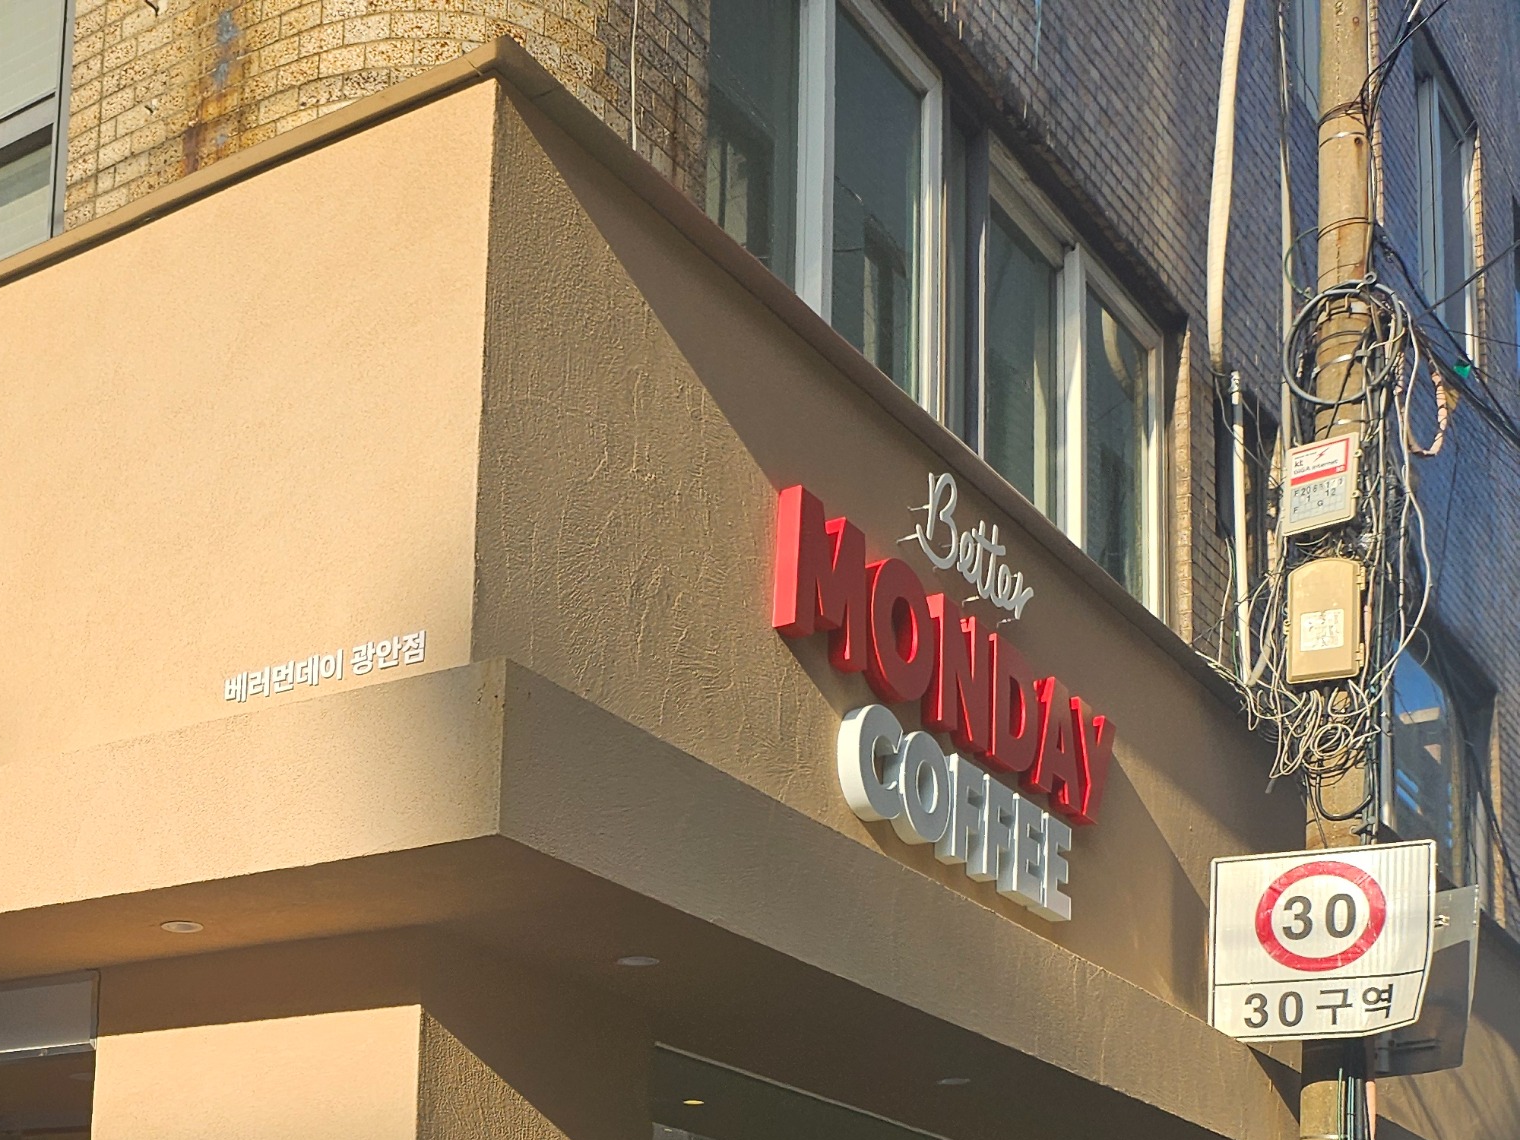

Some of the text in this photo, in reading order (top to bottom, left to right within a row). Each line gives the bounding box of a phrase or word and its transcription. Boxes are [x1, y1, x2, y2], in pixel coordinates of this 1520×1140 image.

[915, 472, 1034, 620] Better
[224, 630, 427, 703] 베러먼데이 광안점
[773, 485, 1116, 825] MONDAY
[837, 704, 1072, 921] COFFEE
[1282, 893, 1357, 941] 30
